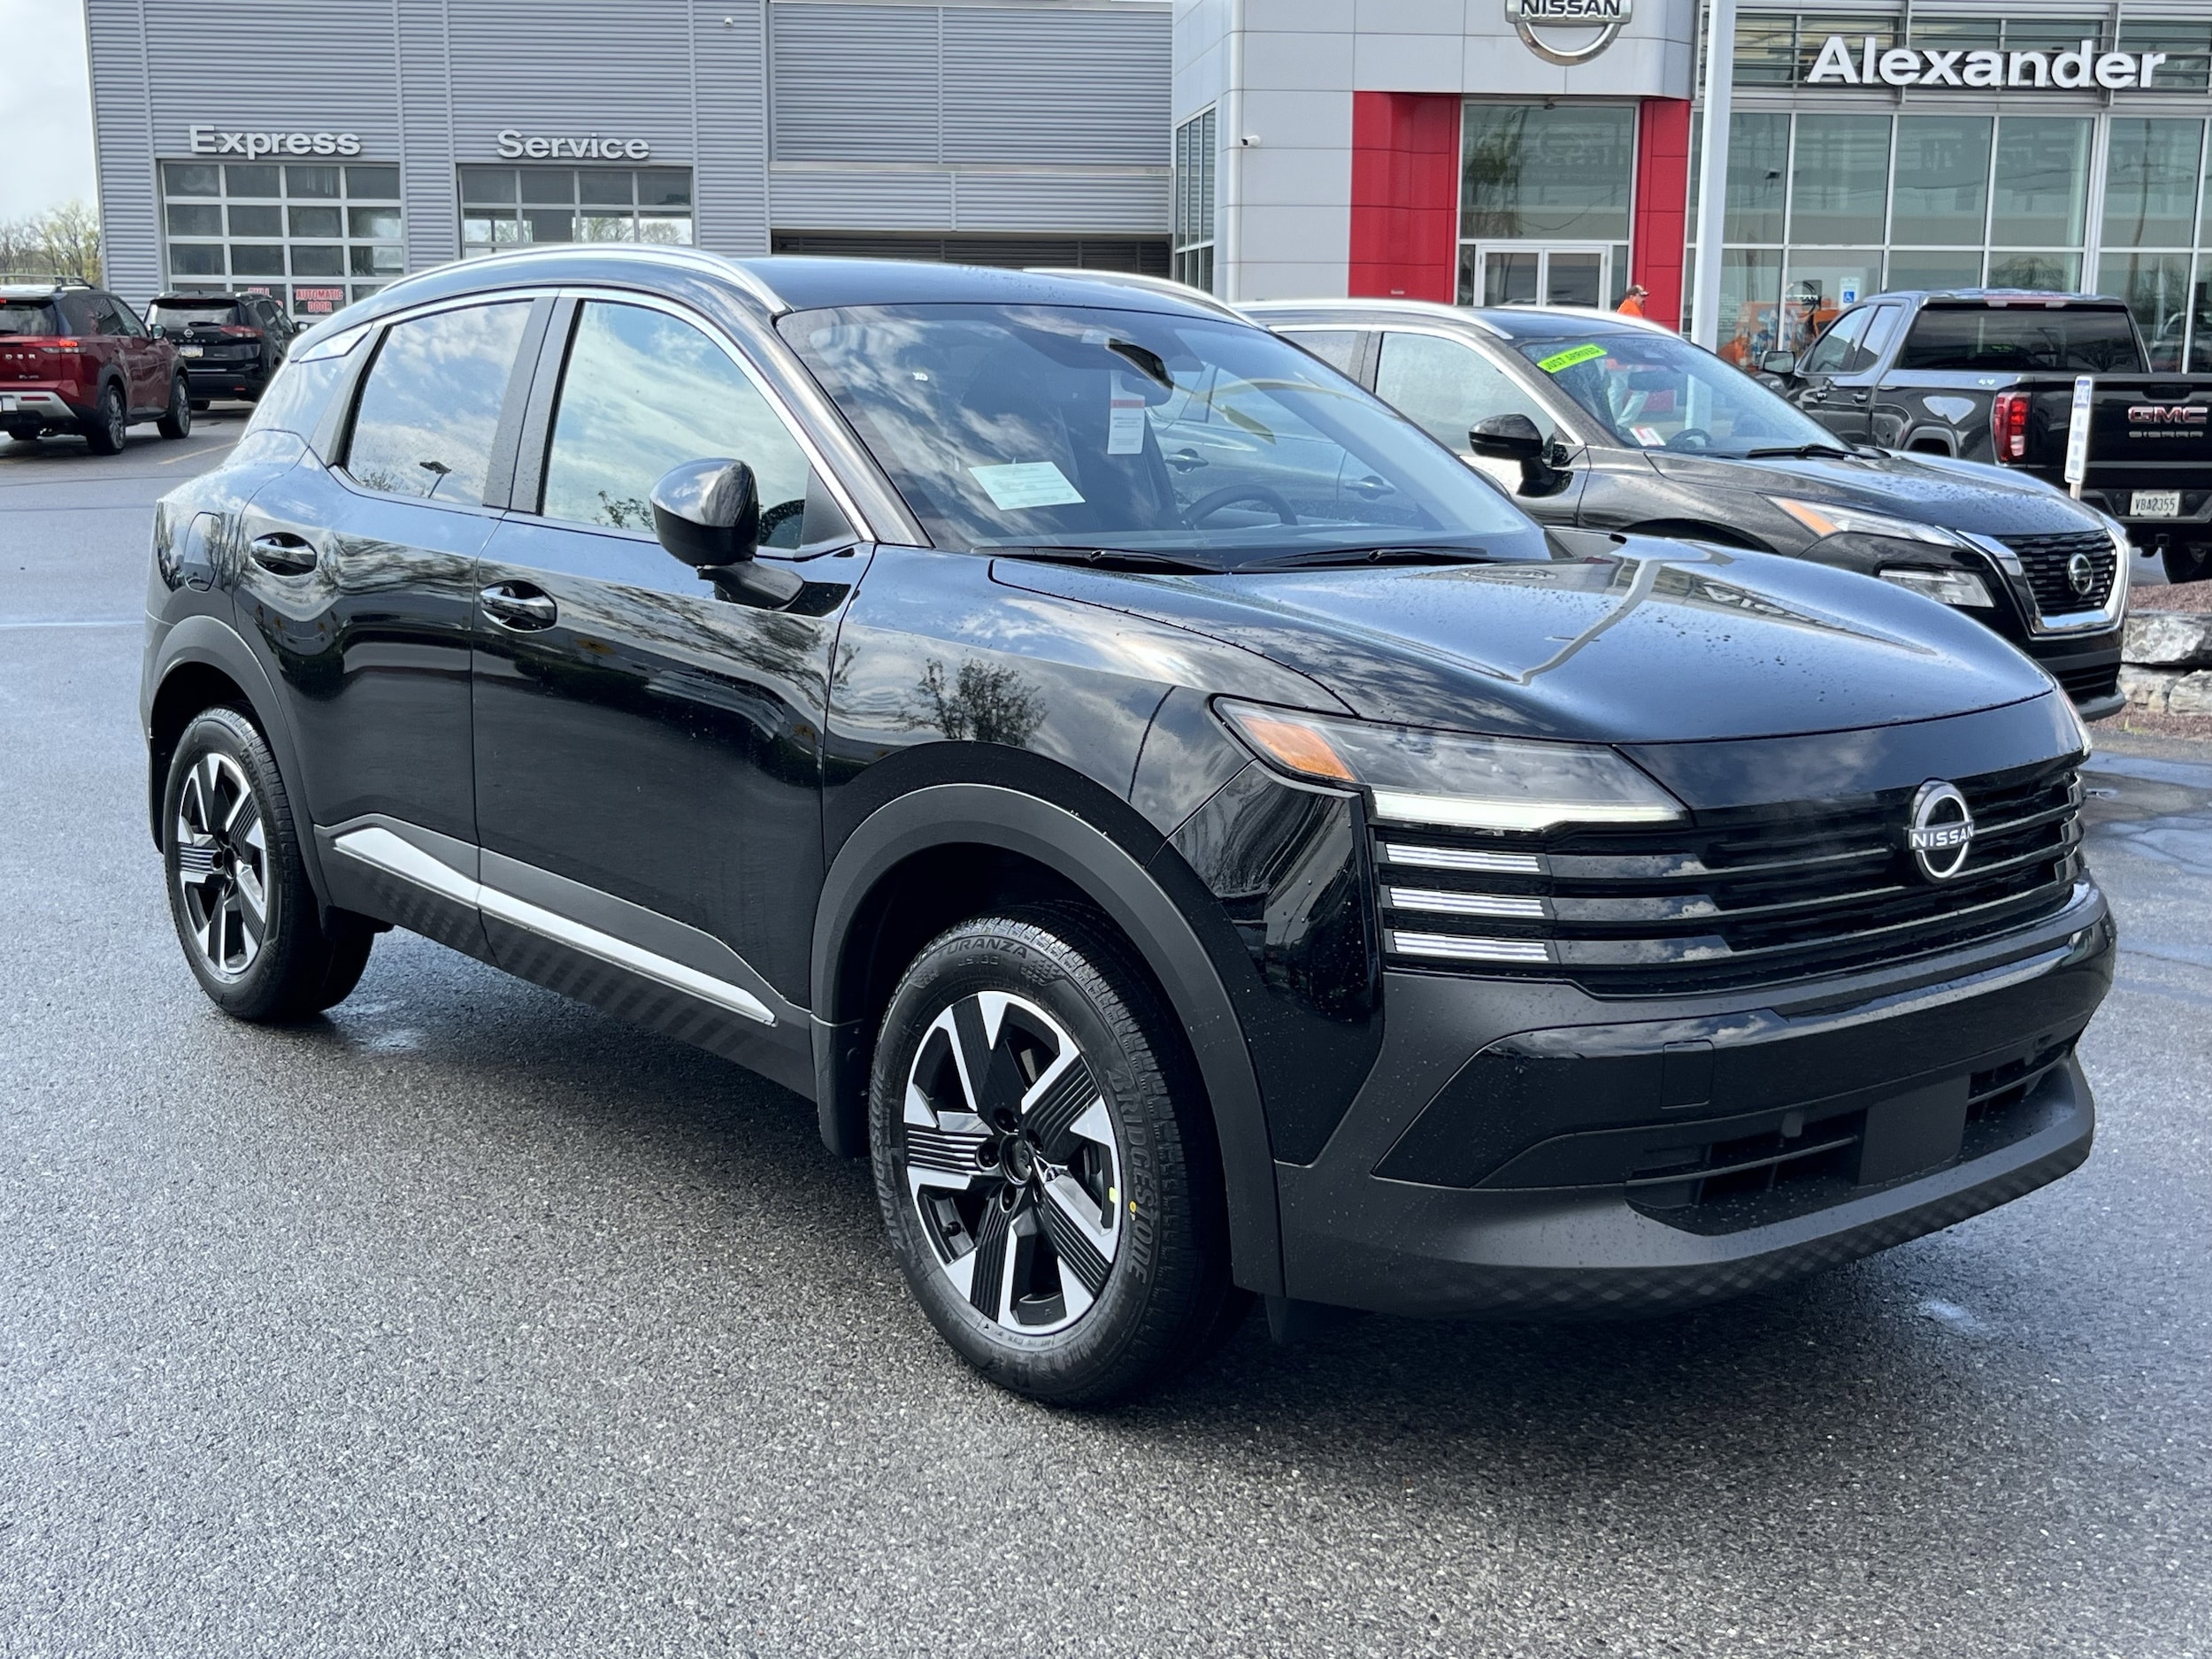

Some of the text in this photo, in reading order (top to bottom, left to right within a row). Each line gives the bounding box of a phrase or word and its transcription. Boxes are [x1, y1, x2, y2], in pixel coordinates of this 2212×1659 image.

[1520, 0, 1621, 18] NISSAN
[1807, 36, 2167, 88] Alexander
[189, 125, 361, 160] Express
[497, 129, 650, 159] Service
[296, 288, 344, 301] AUTOMATIC
[307, 301, 333, 312] DOOR
[1544, 357, 1566, 370] JUST
[2128, 406, 2208, 425] GMC
[2135, 497, 2176, 511] VBA2355
[1912, 825, 1974, 848] NISSAN
[936, 938, 1029, 960] TURANZA
[1106, 1068, 1156, 1283] BRIDGESTONE
